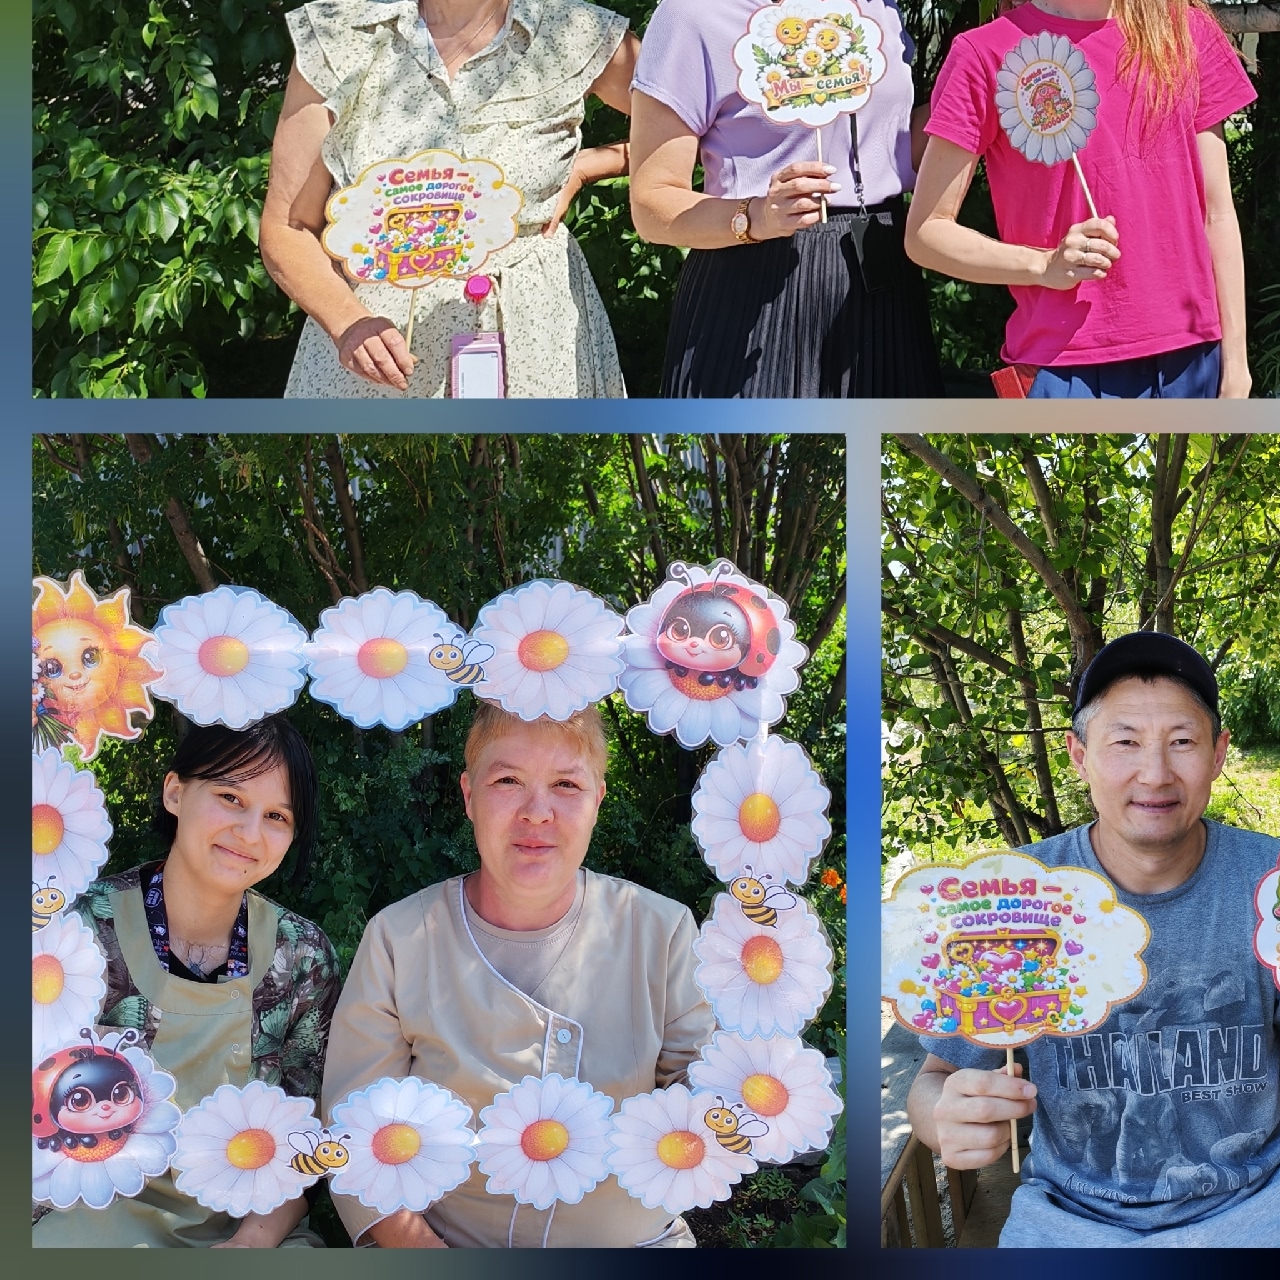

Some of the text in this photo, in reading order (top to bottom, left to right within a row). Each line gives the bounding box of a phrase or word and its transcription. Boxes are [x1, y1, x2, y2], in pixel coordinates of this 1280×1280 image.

[771, 80, 802, 98] Мы
[816, 64, 867, 90] семья!
[389, 168, 454, 184] Семья
[385, 182, 474, 197] самое дорогое
[393, 192, 465, 205] сокровище
[937, 877, 1037, 900] Семья
[936, 899, 1073, 917] самое дорогое
[951, 912, 1062, 928] сокровище
[1046, 1024, 1268, 1096] THAILAND
[1182, 1081, 1268, 1104] BEST SHOW
